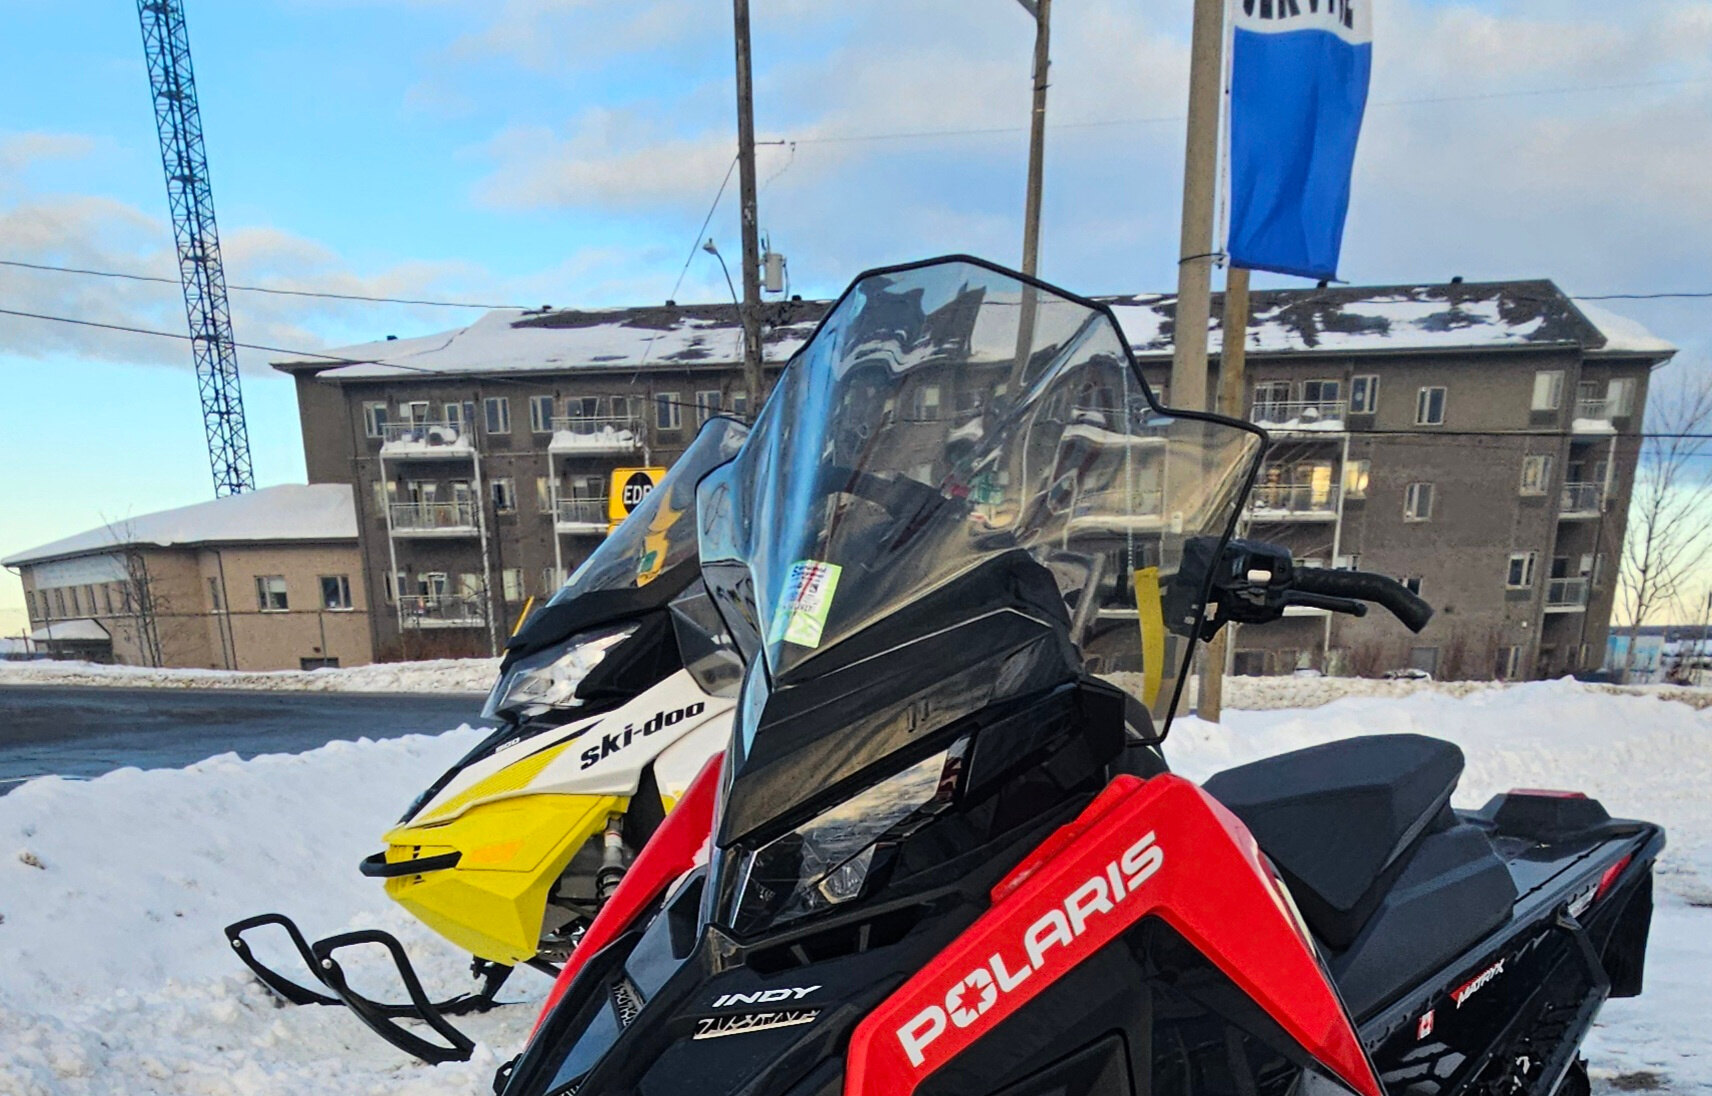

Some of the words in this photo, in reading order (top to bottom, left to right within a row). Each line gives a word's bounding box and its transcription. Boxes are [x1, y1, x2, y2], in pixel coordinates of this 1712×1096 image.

[580, 702, 705, 770] ski-doo
[896, 830, 1163, 1068] POLARIS
[712, 985, 822, 1008] INDY
